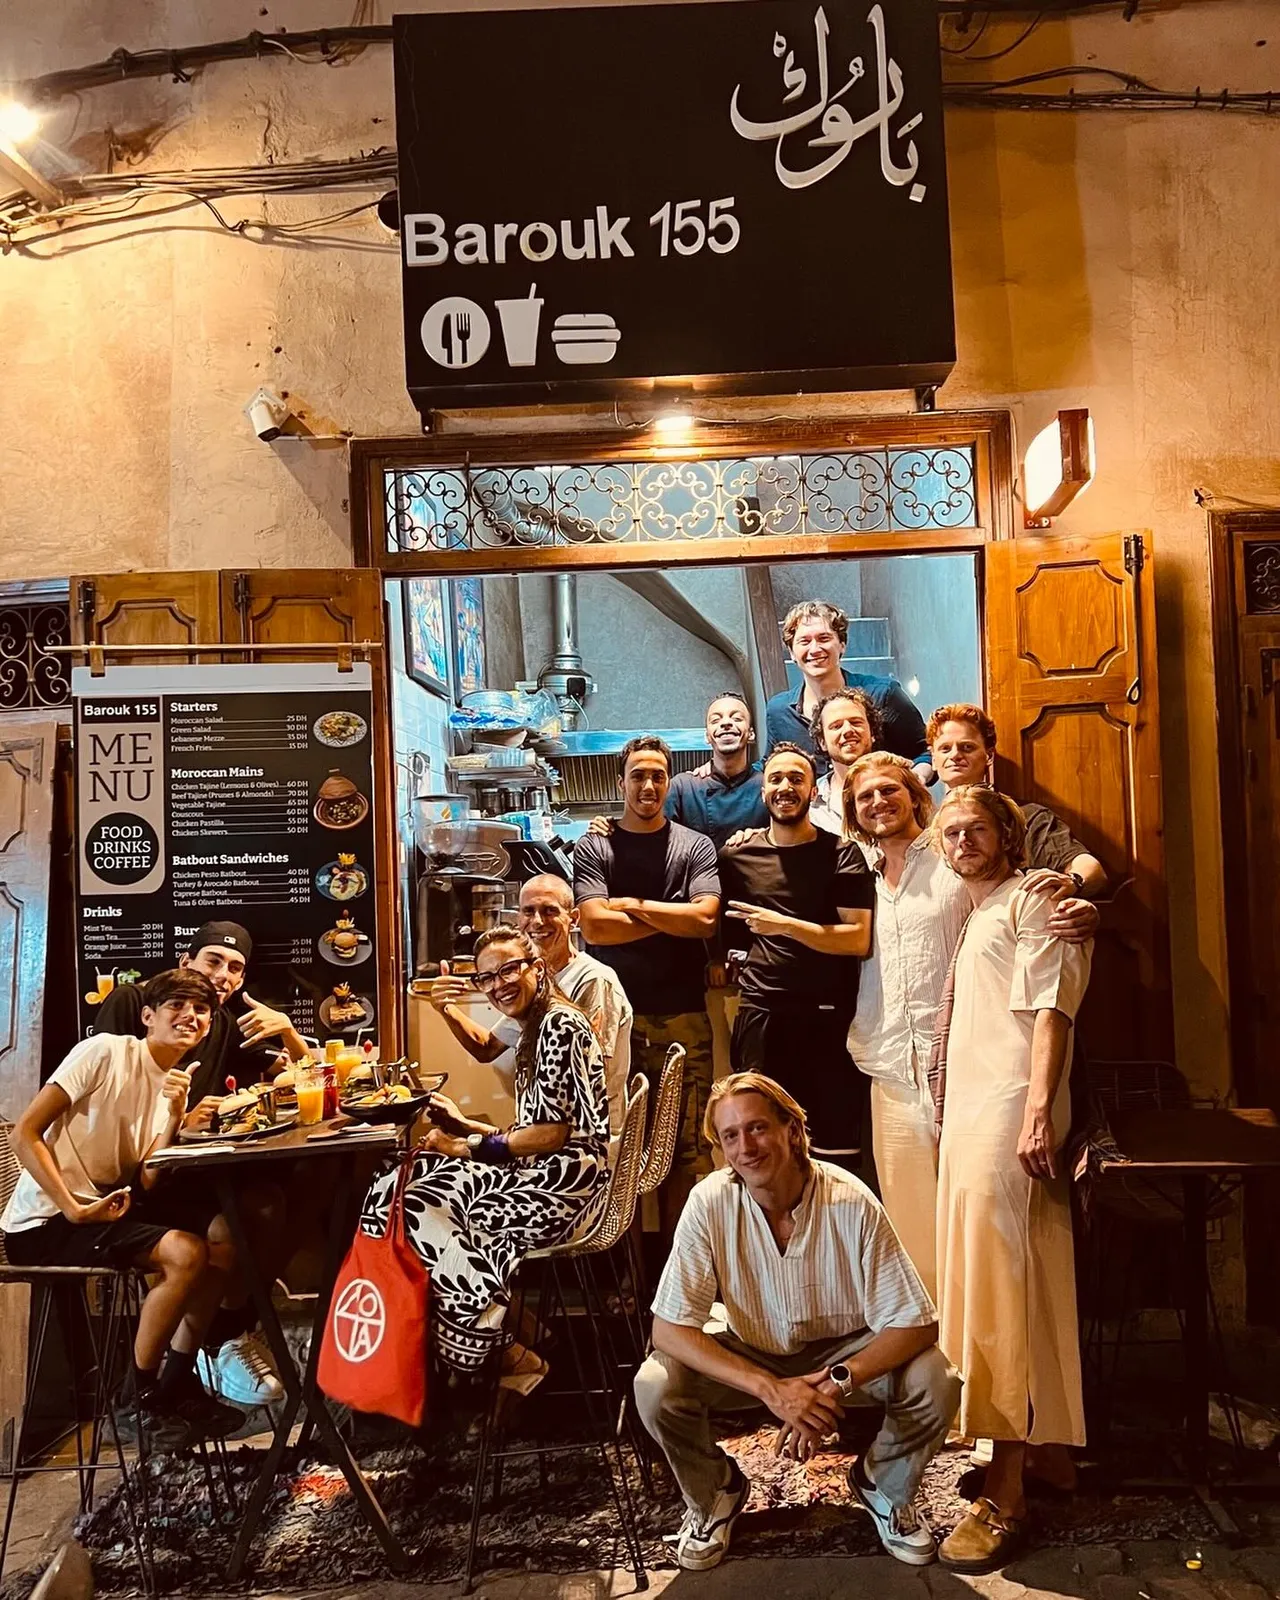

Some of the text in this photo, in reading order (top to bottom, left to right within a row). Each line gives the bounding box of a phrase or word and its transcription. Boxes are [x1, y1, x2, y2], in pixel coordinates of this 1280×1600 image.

[404, 197, 740, 266] Barouk 155
[84, 704, 157, 716] Barouk 155
[170, 702, 218, 712] Starters
[89, 733, 152, 765] ME
[171, 766, 264, 778] Moroccan Mains
[89, 770, 154, 802] NU
[199, 782, 219, 790] Tajine
[188, 792, 207, 800] Tajine
[242, 790, 274, 798] Almonds)
[172, 802, 204, 810] Vegetable
[206, 801, 226, 809] Tajine
[101, 826, 143, 839] FOOD
[93, 840, 151, 854] DRINKS
[94, 856, 151, 869] COFFEE
[173, 853, 289, 865] Batbout Sandwiches
[173, 881, 196, 889] Turkey
[83, 906, 122, 917] Drinks
